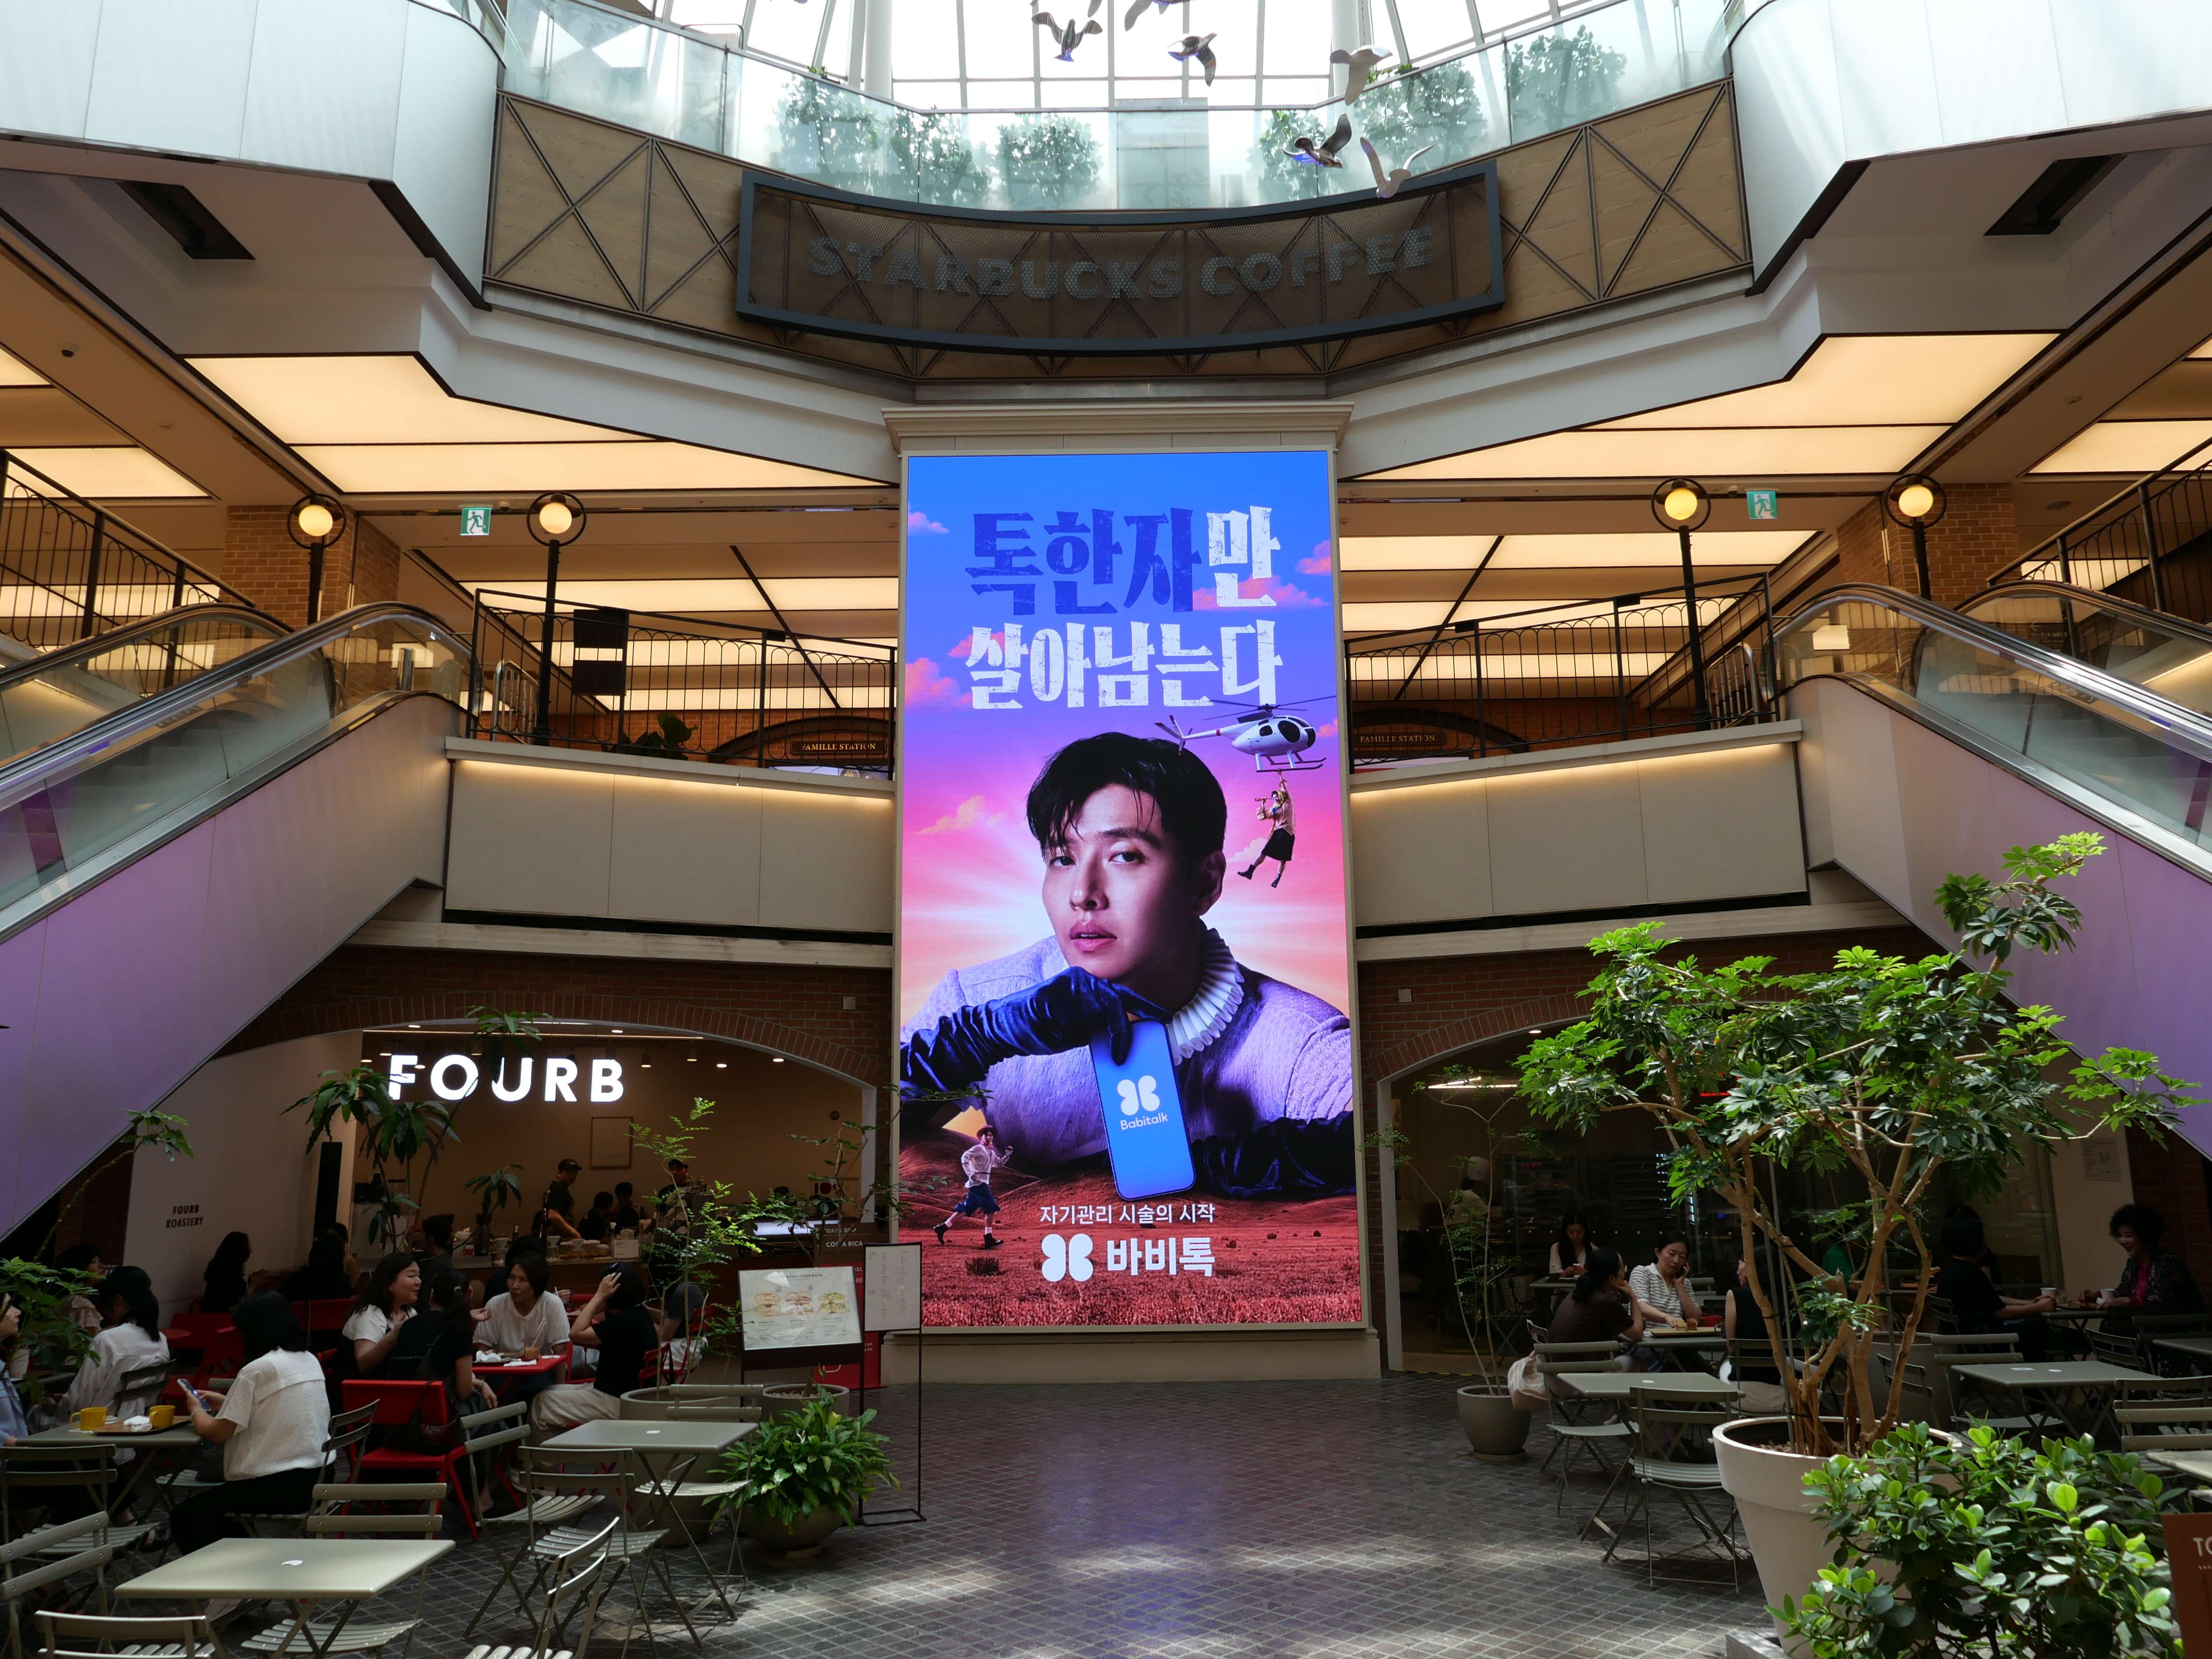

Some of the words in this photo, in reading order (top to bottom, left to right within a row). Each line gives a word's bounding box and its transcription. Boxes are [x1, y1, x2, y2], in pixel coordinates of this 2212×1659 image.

[808, 236, 1183, 299] STARBUCKS
[1201, 226, 1435, 295] COFFEE
[965, 506, 1281, 616] 톡한자만
[966, 619, 1283, 709] 살아남는다
[389, 1054, 624, 1102] FOURB
[1120, 1112, 1168, 1130] Babitalk
[166, 1217, 204, 1228] ROASTERY
[173, 1204, 199, 1215] FOURB
[1040, 1205, 1113, 1225] 자기관리
[1119, 1204, 1173, 1224] 시술의
[1179, 1203, 1215, 1223] 시작
[1107, 1237, 1215, 1276] 바비톡
